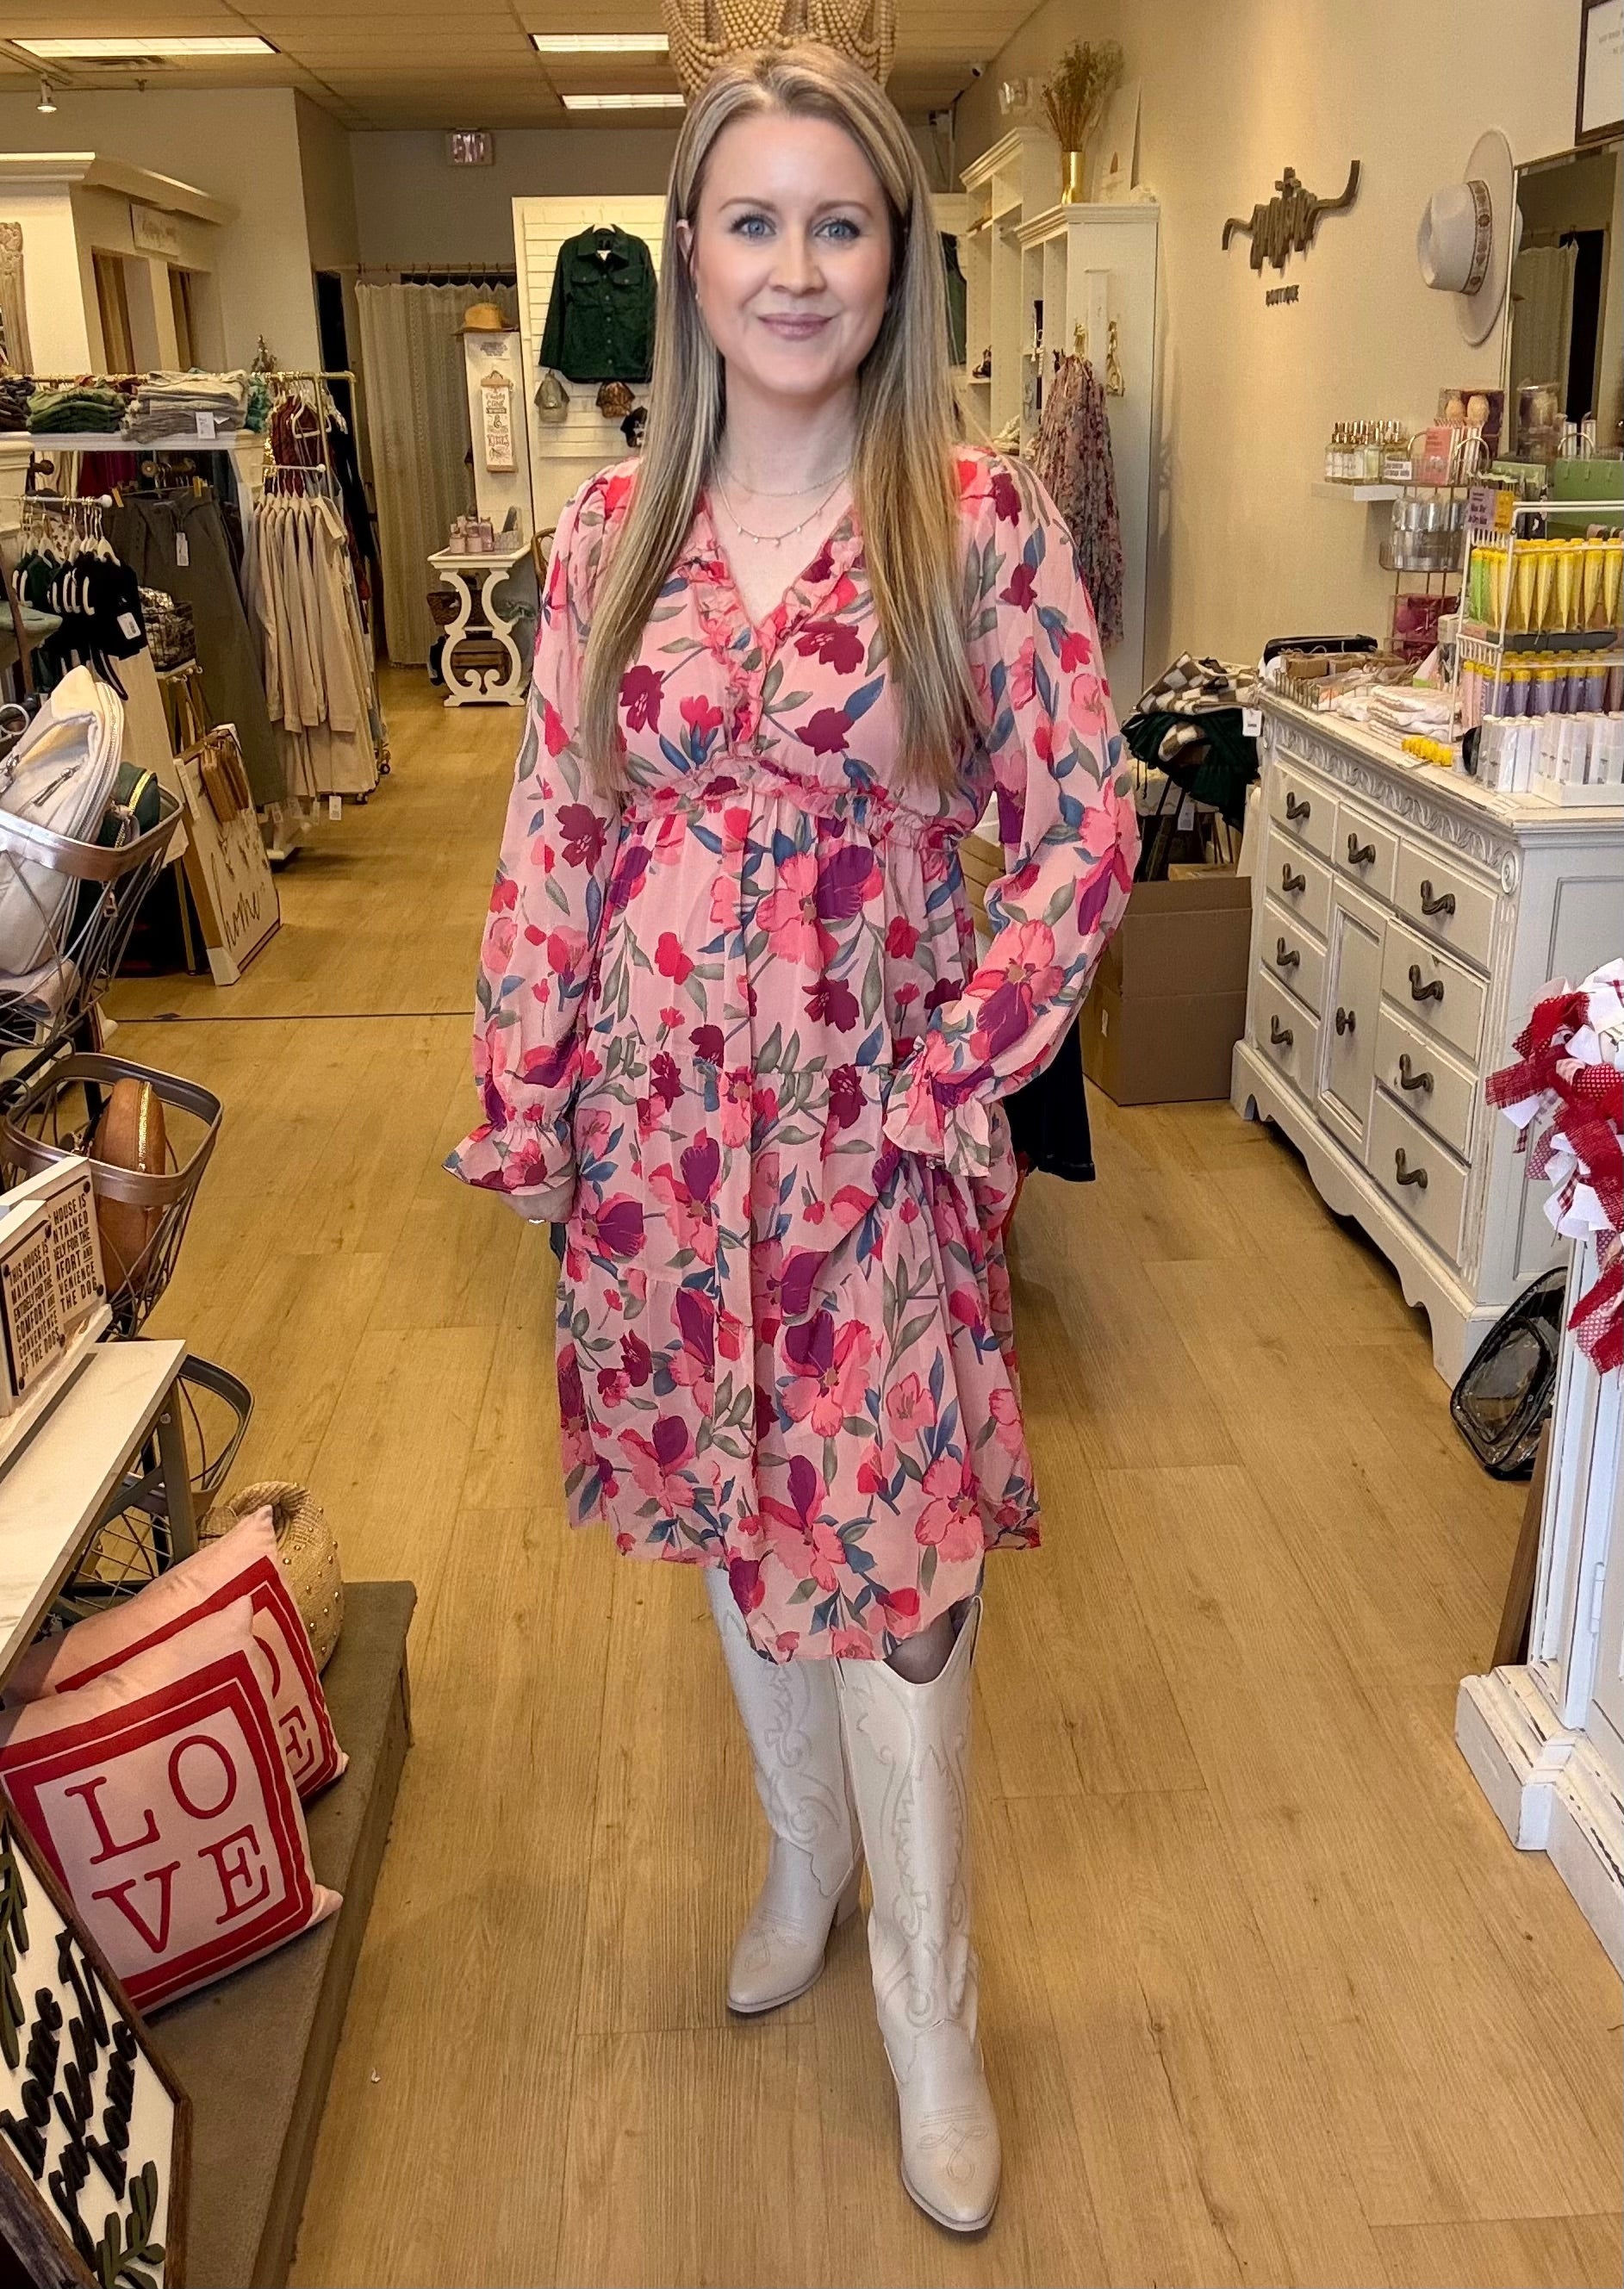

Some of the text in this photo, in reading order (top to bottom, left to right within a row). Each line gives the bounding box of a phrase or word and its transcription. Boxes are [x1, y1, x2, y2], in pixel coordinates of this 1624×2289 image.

[53, 1192, 86, 1226] HOUSE IS
[53, 1210, 89, 1244] NTAINED
[67, 1235, 79, 1253] FOR
[78, 1227, 91, 1245] THE
[9, 1238, 48, 1287] THIS HOUSE IS
[56, 1250, 80, 1280] FORT
[59, 1261, 95, 1296] VENIENCE
[11, 1256, 51, 1305] MAINTAINED
[34, 1283, 44, 1303] FOR
[43, 1273, 53, 1292] THE
[60, 1290, 78, 1313] THE
[16, 1298, 47, 1343] COMFORT
[19, 1309, 58, 1359] CONVENIENCE
[21, 1356, 28, 1378] OF
[30, 1343, 43, 1367] THE
